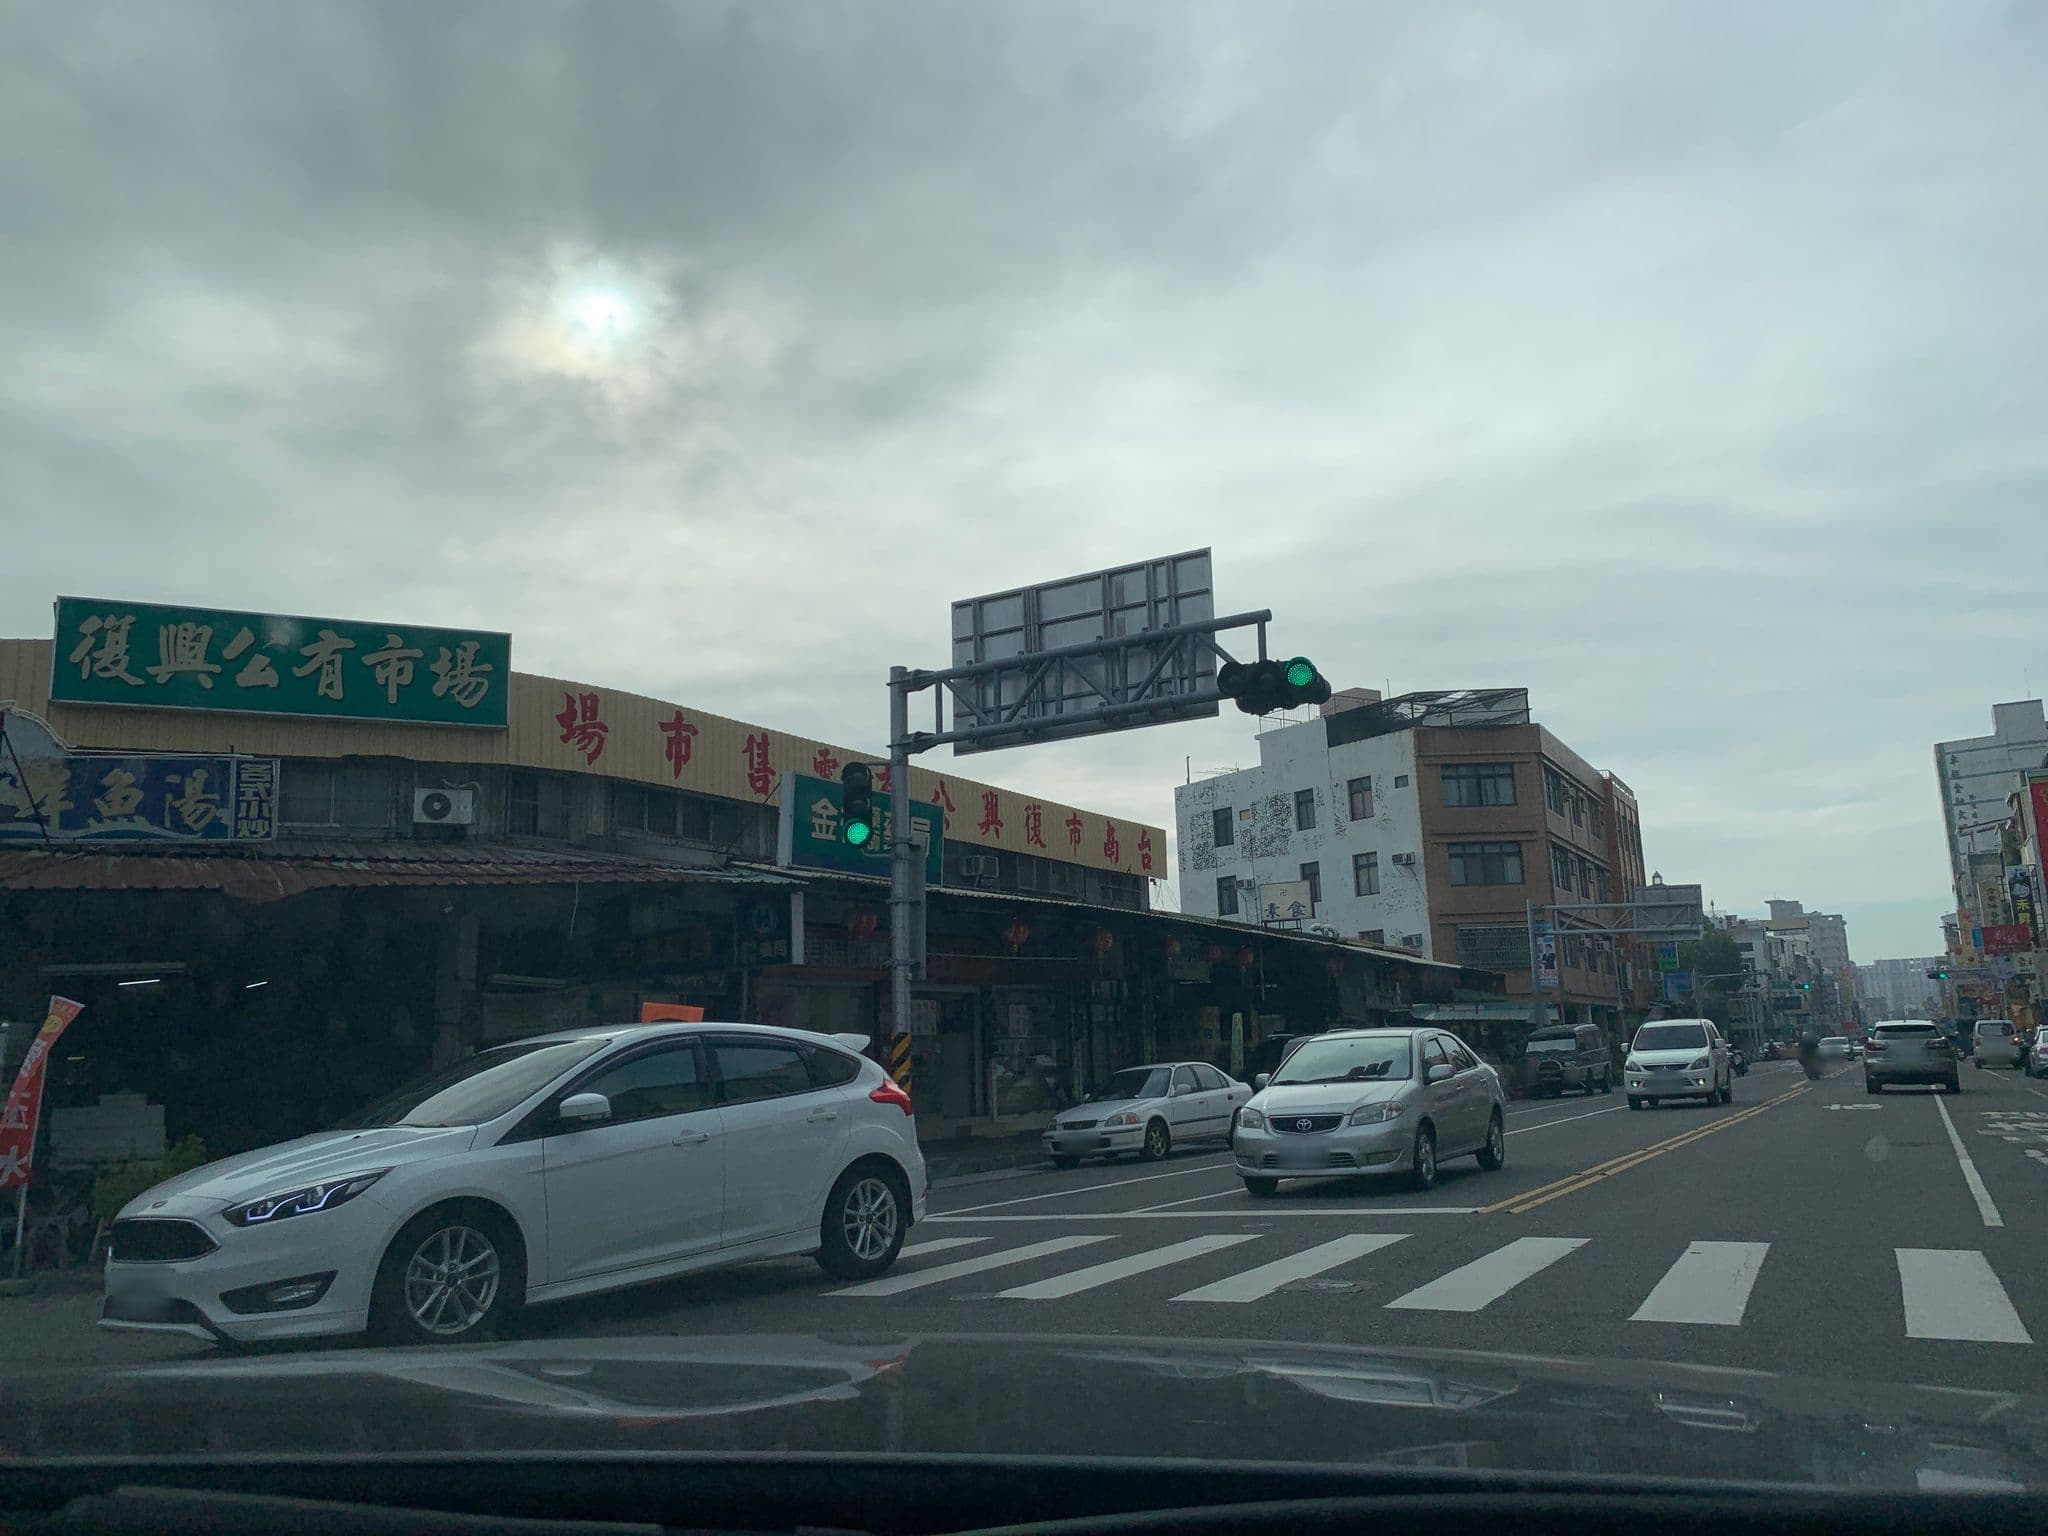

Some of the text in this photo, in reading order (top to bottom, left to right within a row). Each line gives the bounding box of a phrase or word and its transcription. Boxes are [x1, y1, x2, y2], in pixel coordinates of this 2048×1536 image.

[70, 614, 494, 708] 復興公有市場
[1263, 900, 1308, 919] 素食
